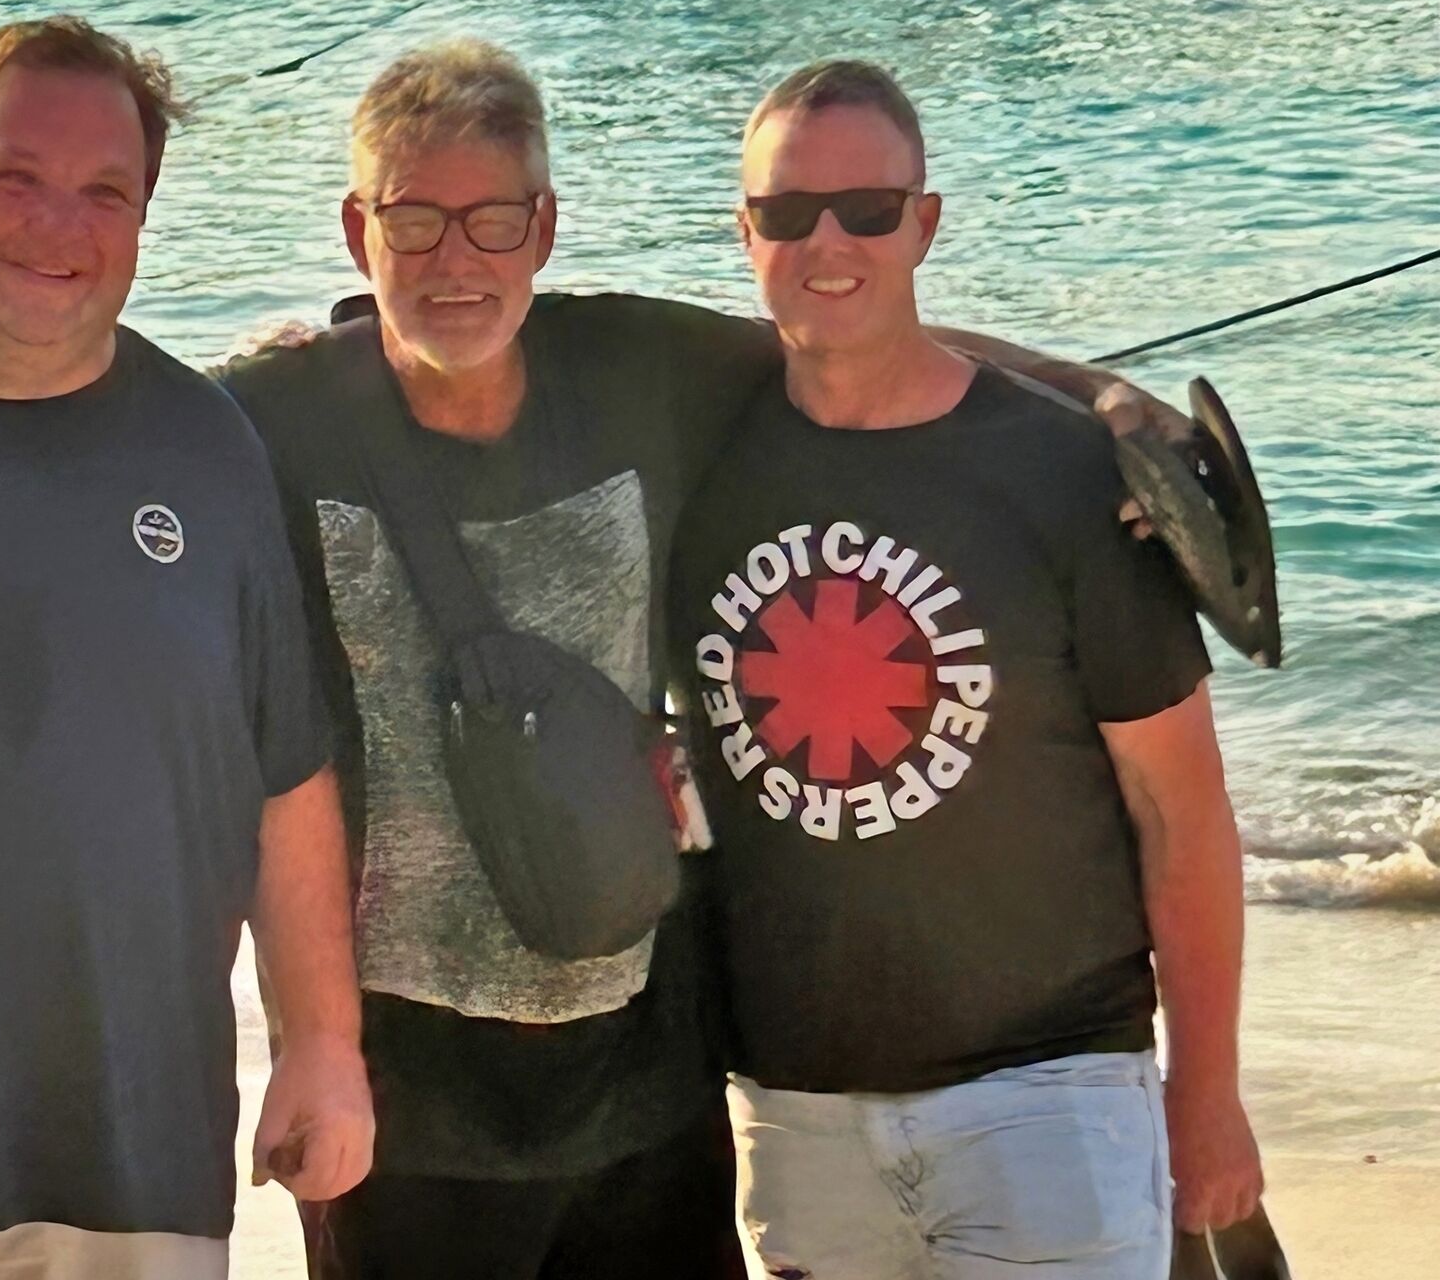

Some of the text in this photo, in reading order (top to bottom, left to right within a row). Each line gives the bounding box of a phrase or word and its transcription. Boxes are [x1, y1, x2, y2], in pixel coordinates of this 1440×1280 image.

[696, 521, 994, 841] RED HOT CHILI PEPPERS
